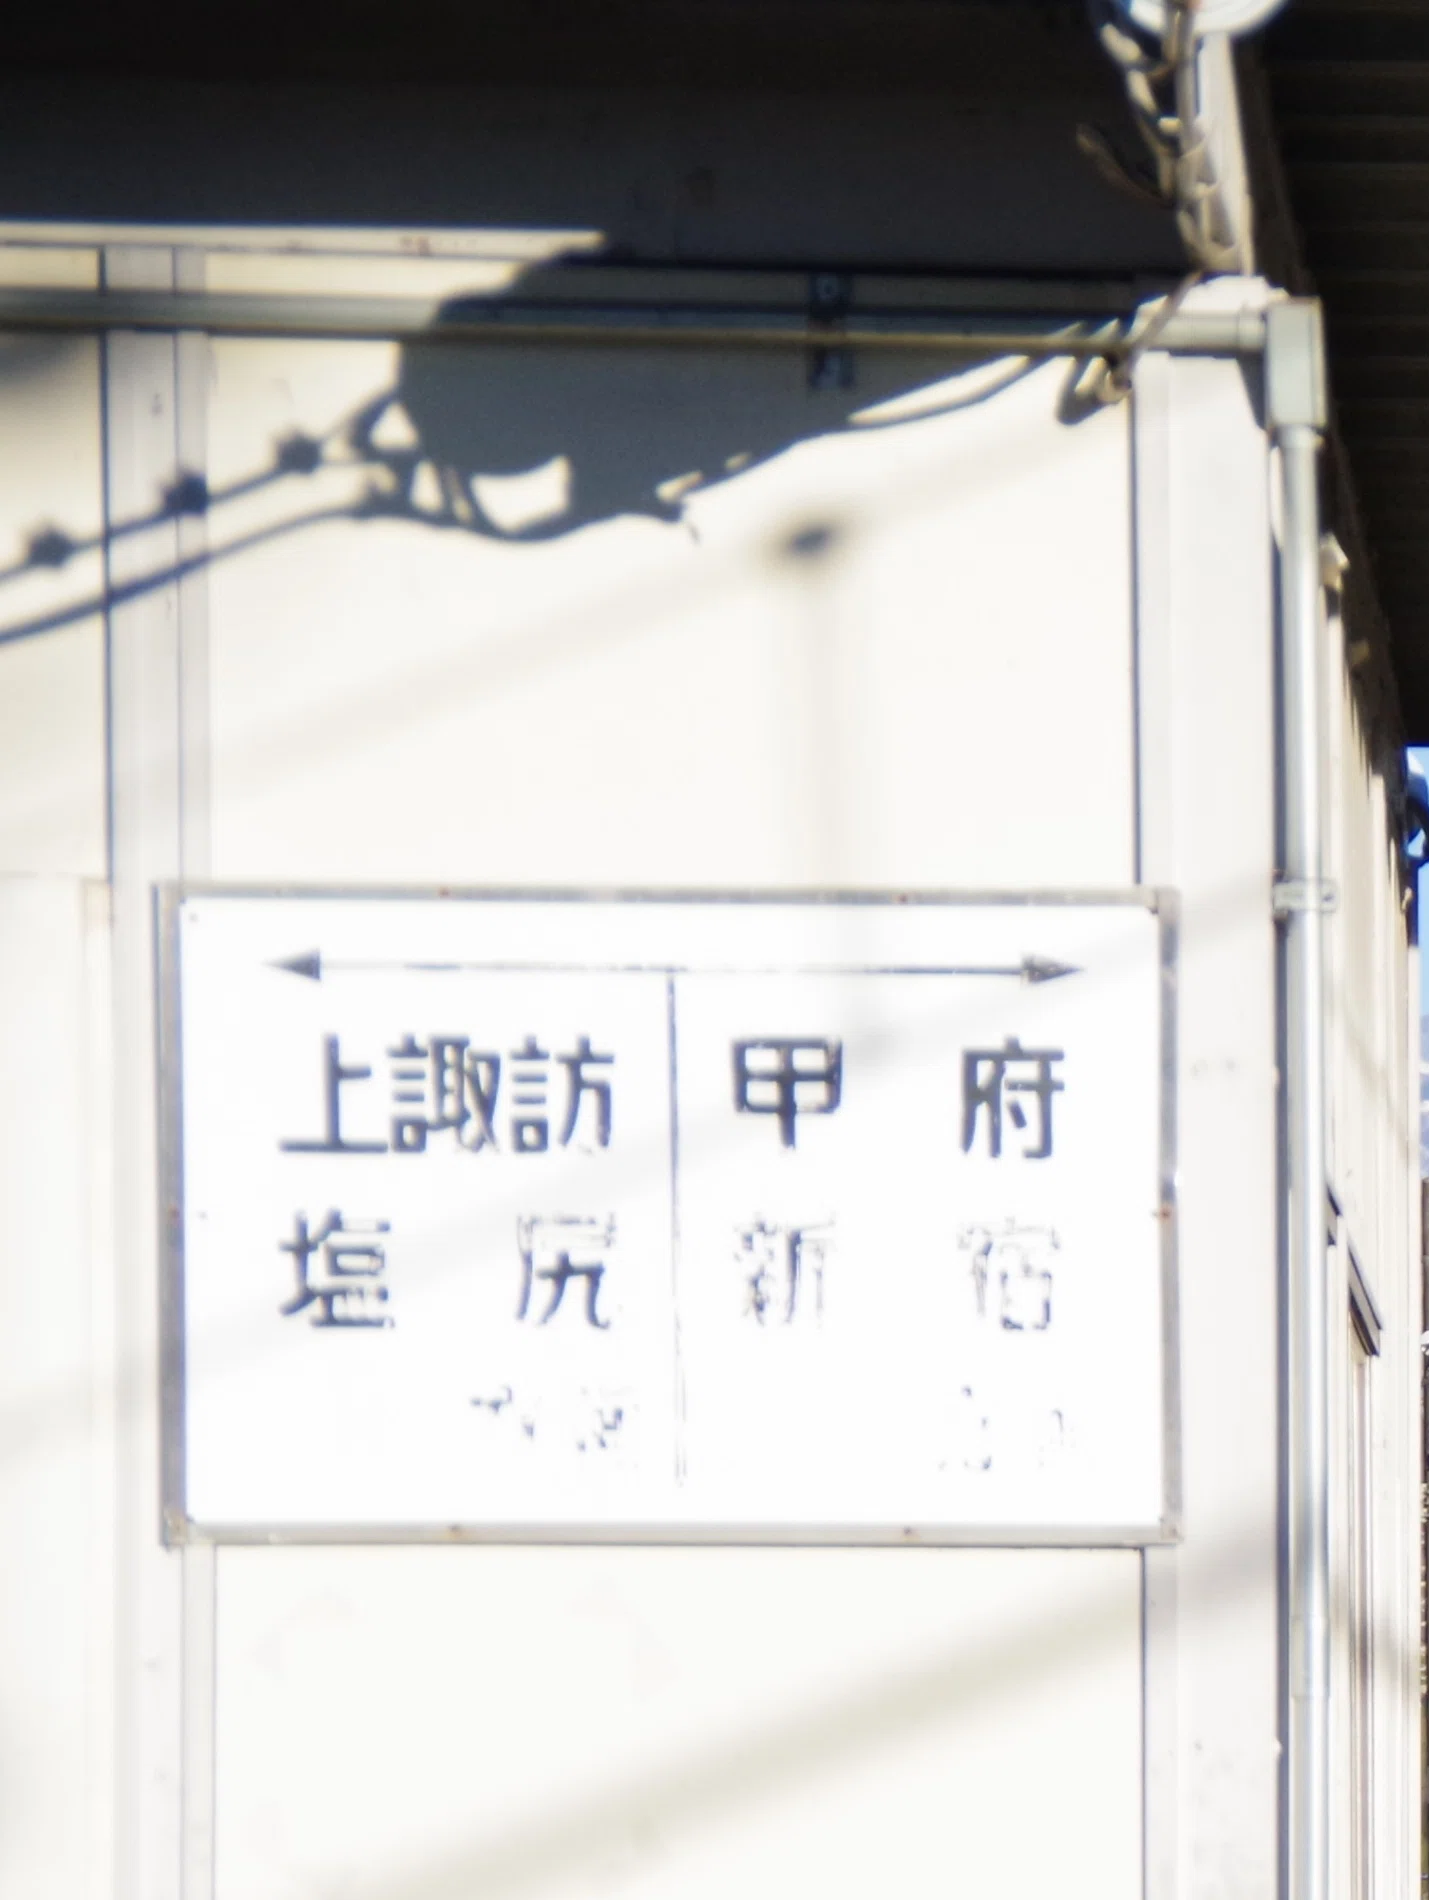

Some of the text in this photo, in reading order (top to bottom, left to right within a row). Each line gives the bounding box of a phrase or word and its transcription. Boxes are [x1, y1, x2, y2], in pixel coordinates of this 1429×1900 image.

[279, 1033, 616, 1154] 上諏訪
[730, 1035, 1066, 1160] 甲府
[277, 1207, 616, 1331] 塩尻
